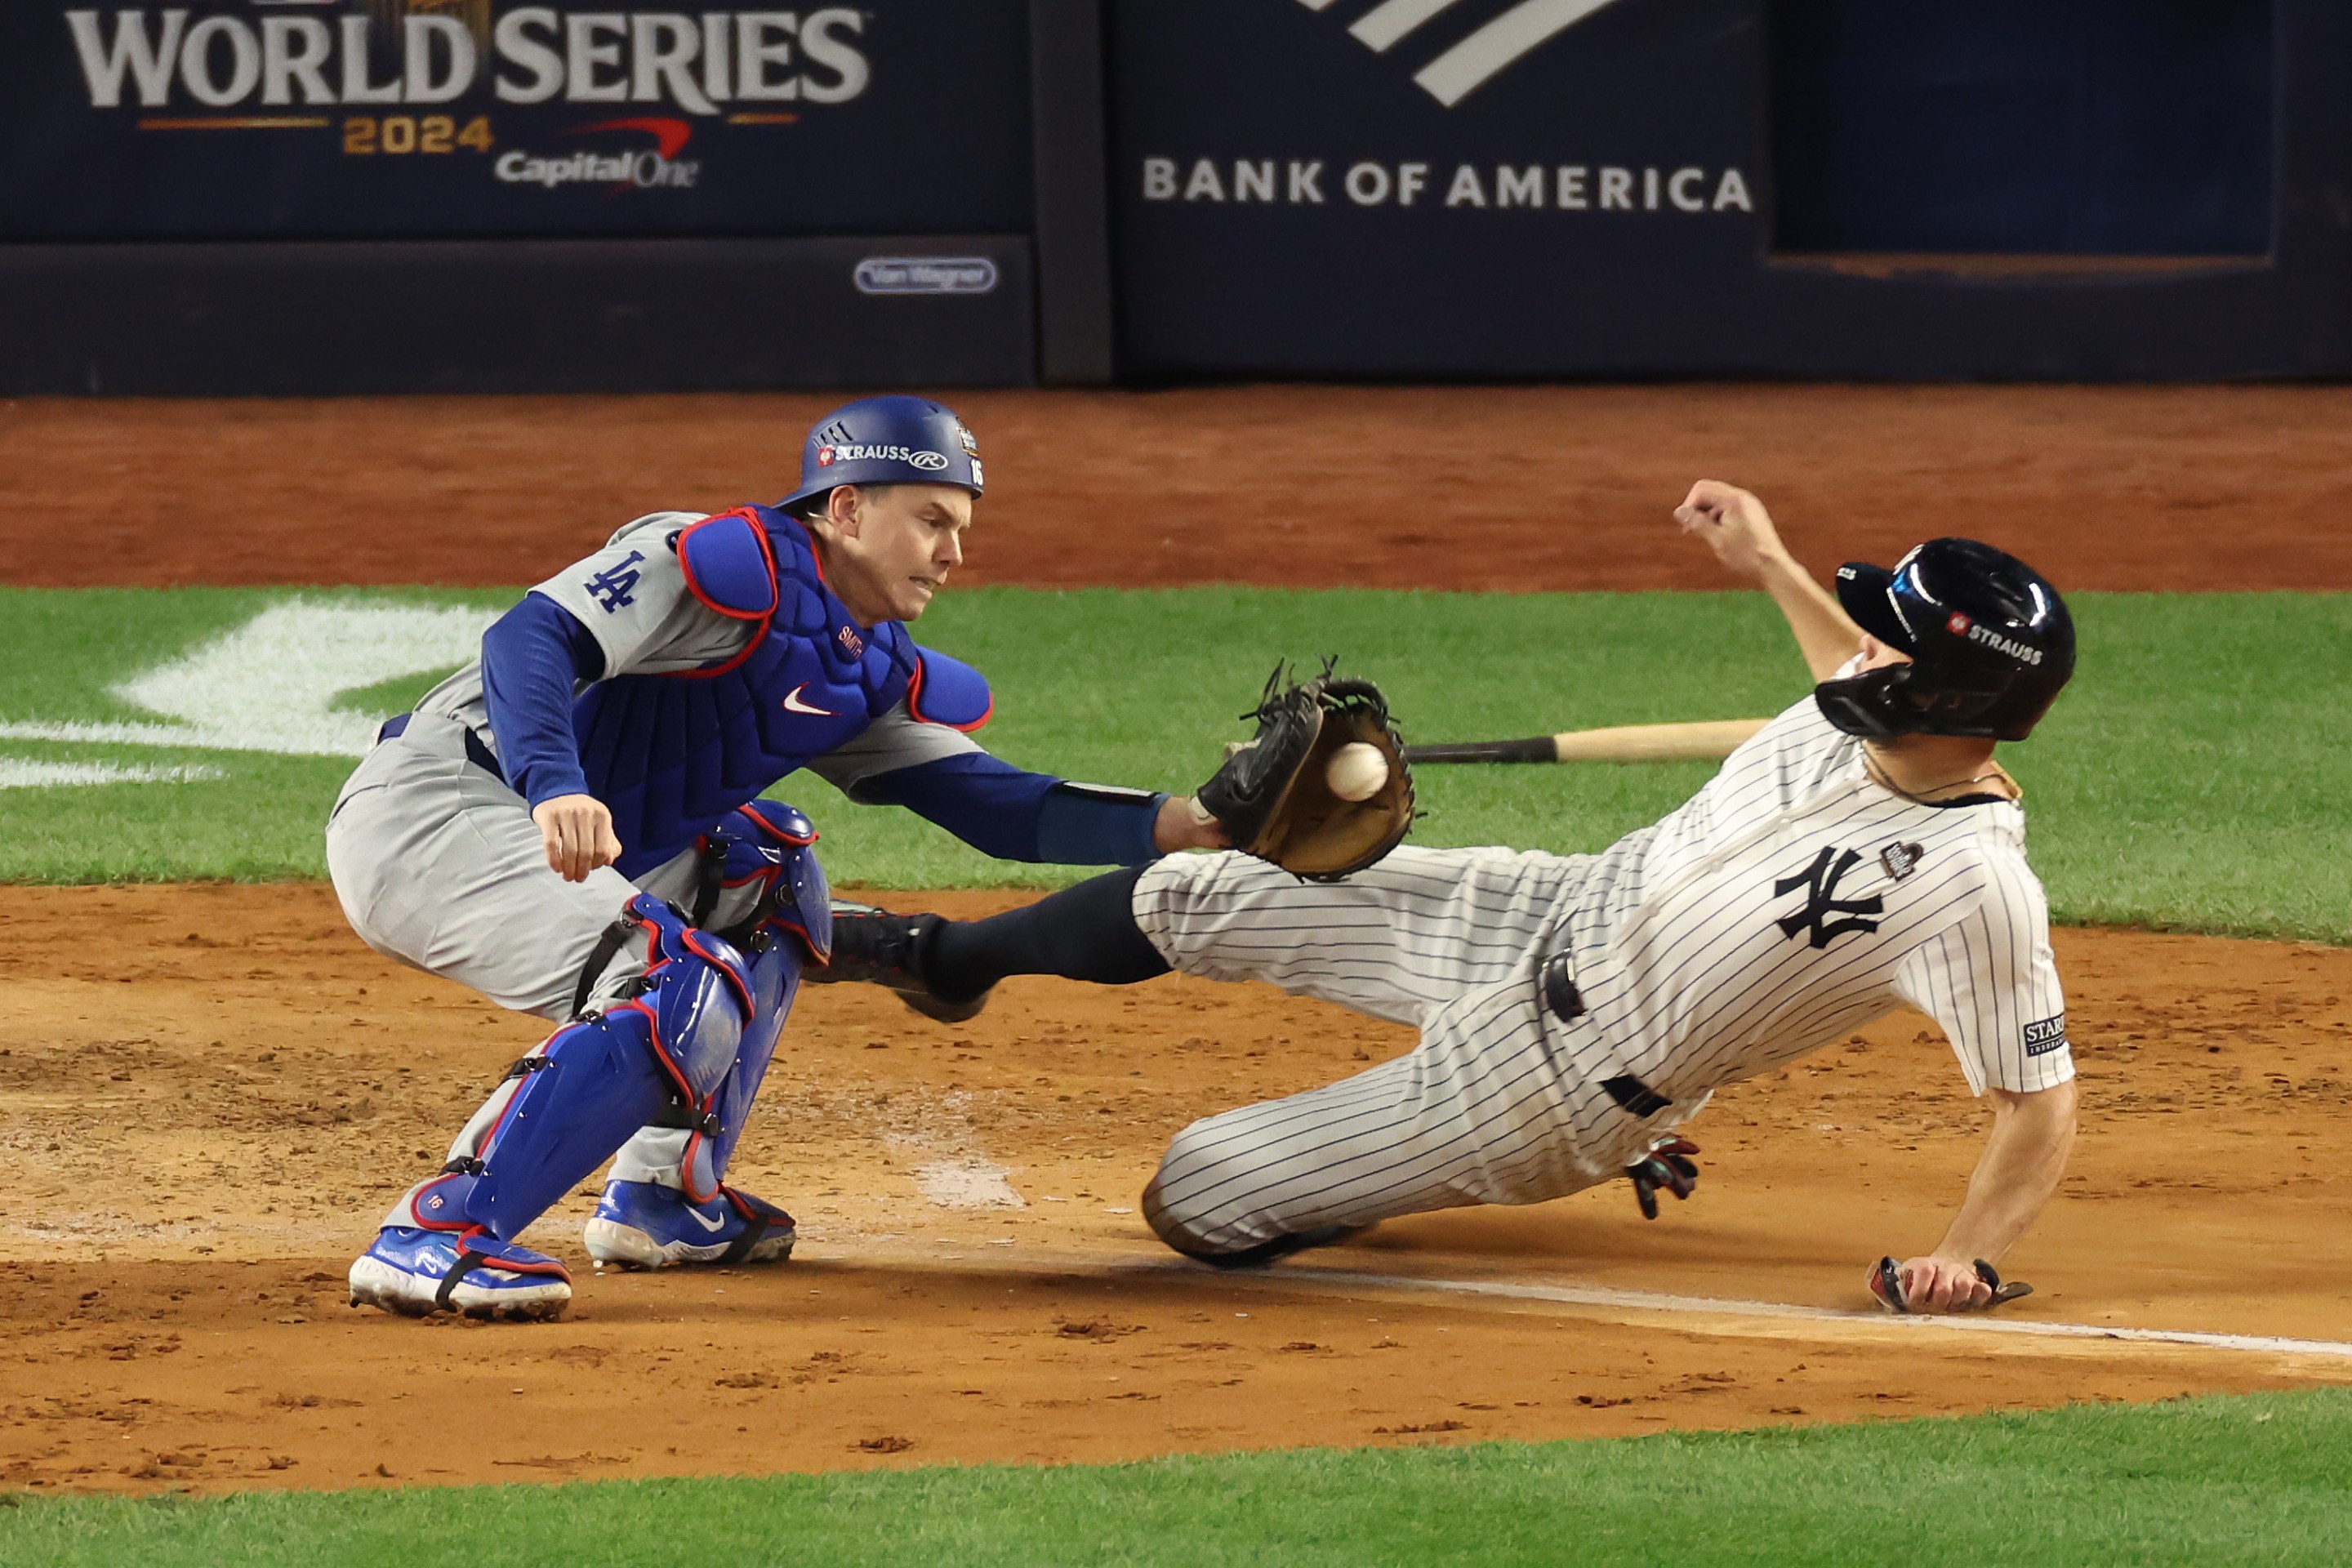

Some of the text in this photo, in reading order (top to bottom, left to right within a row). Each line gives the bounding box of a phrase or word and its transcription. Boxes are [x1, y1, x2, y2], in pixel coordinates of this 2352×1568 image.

[67, 7, 871, 116] WORLD SERIES
[343, 116, 496, 155] 2024
[1143, 158, 1753, 213] BANK OF AMERICA
[835, 444, 910, 462] STRAUSS
[970, 458, 984, 486] 16
[584, 550, 646, 614] LA
[1967, 623, 2043, 666] STRAUSS
[1774, 844, 1885, 950] NY
[427, 1194, 444, 1209] 16
